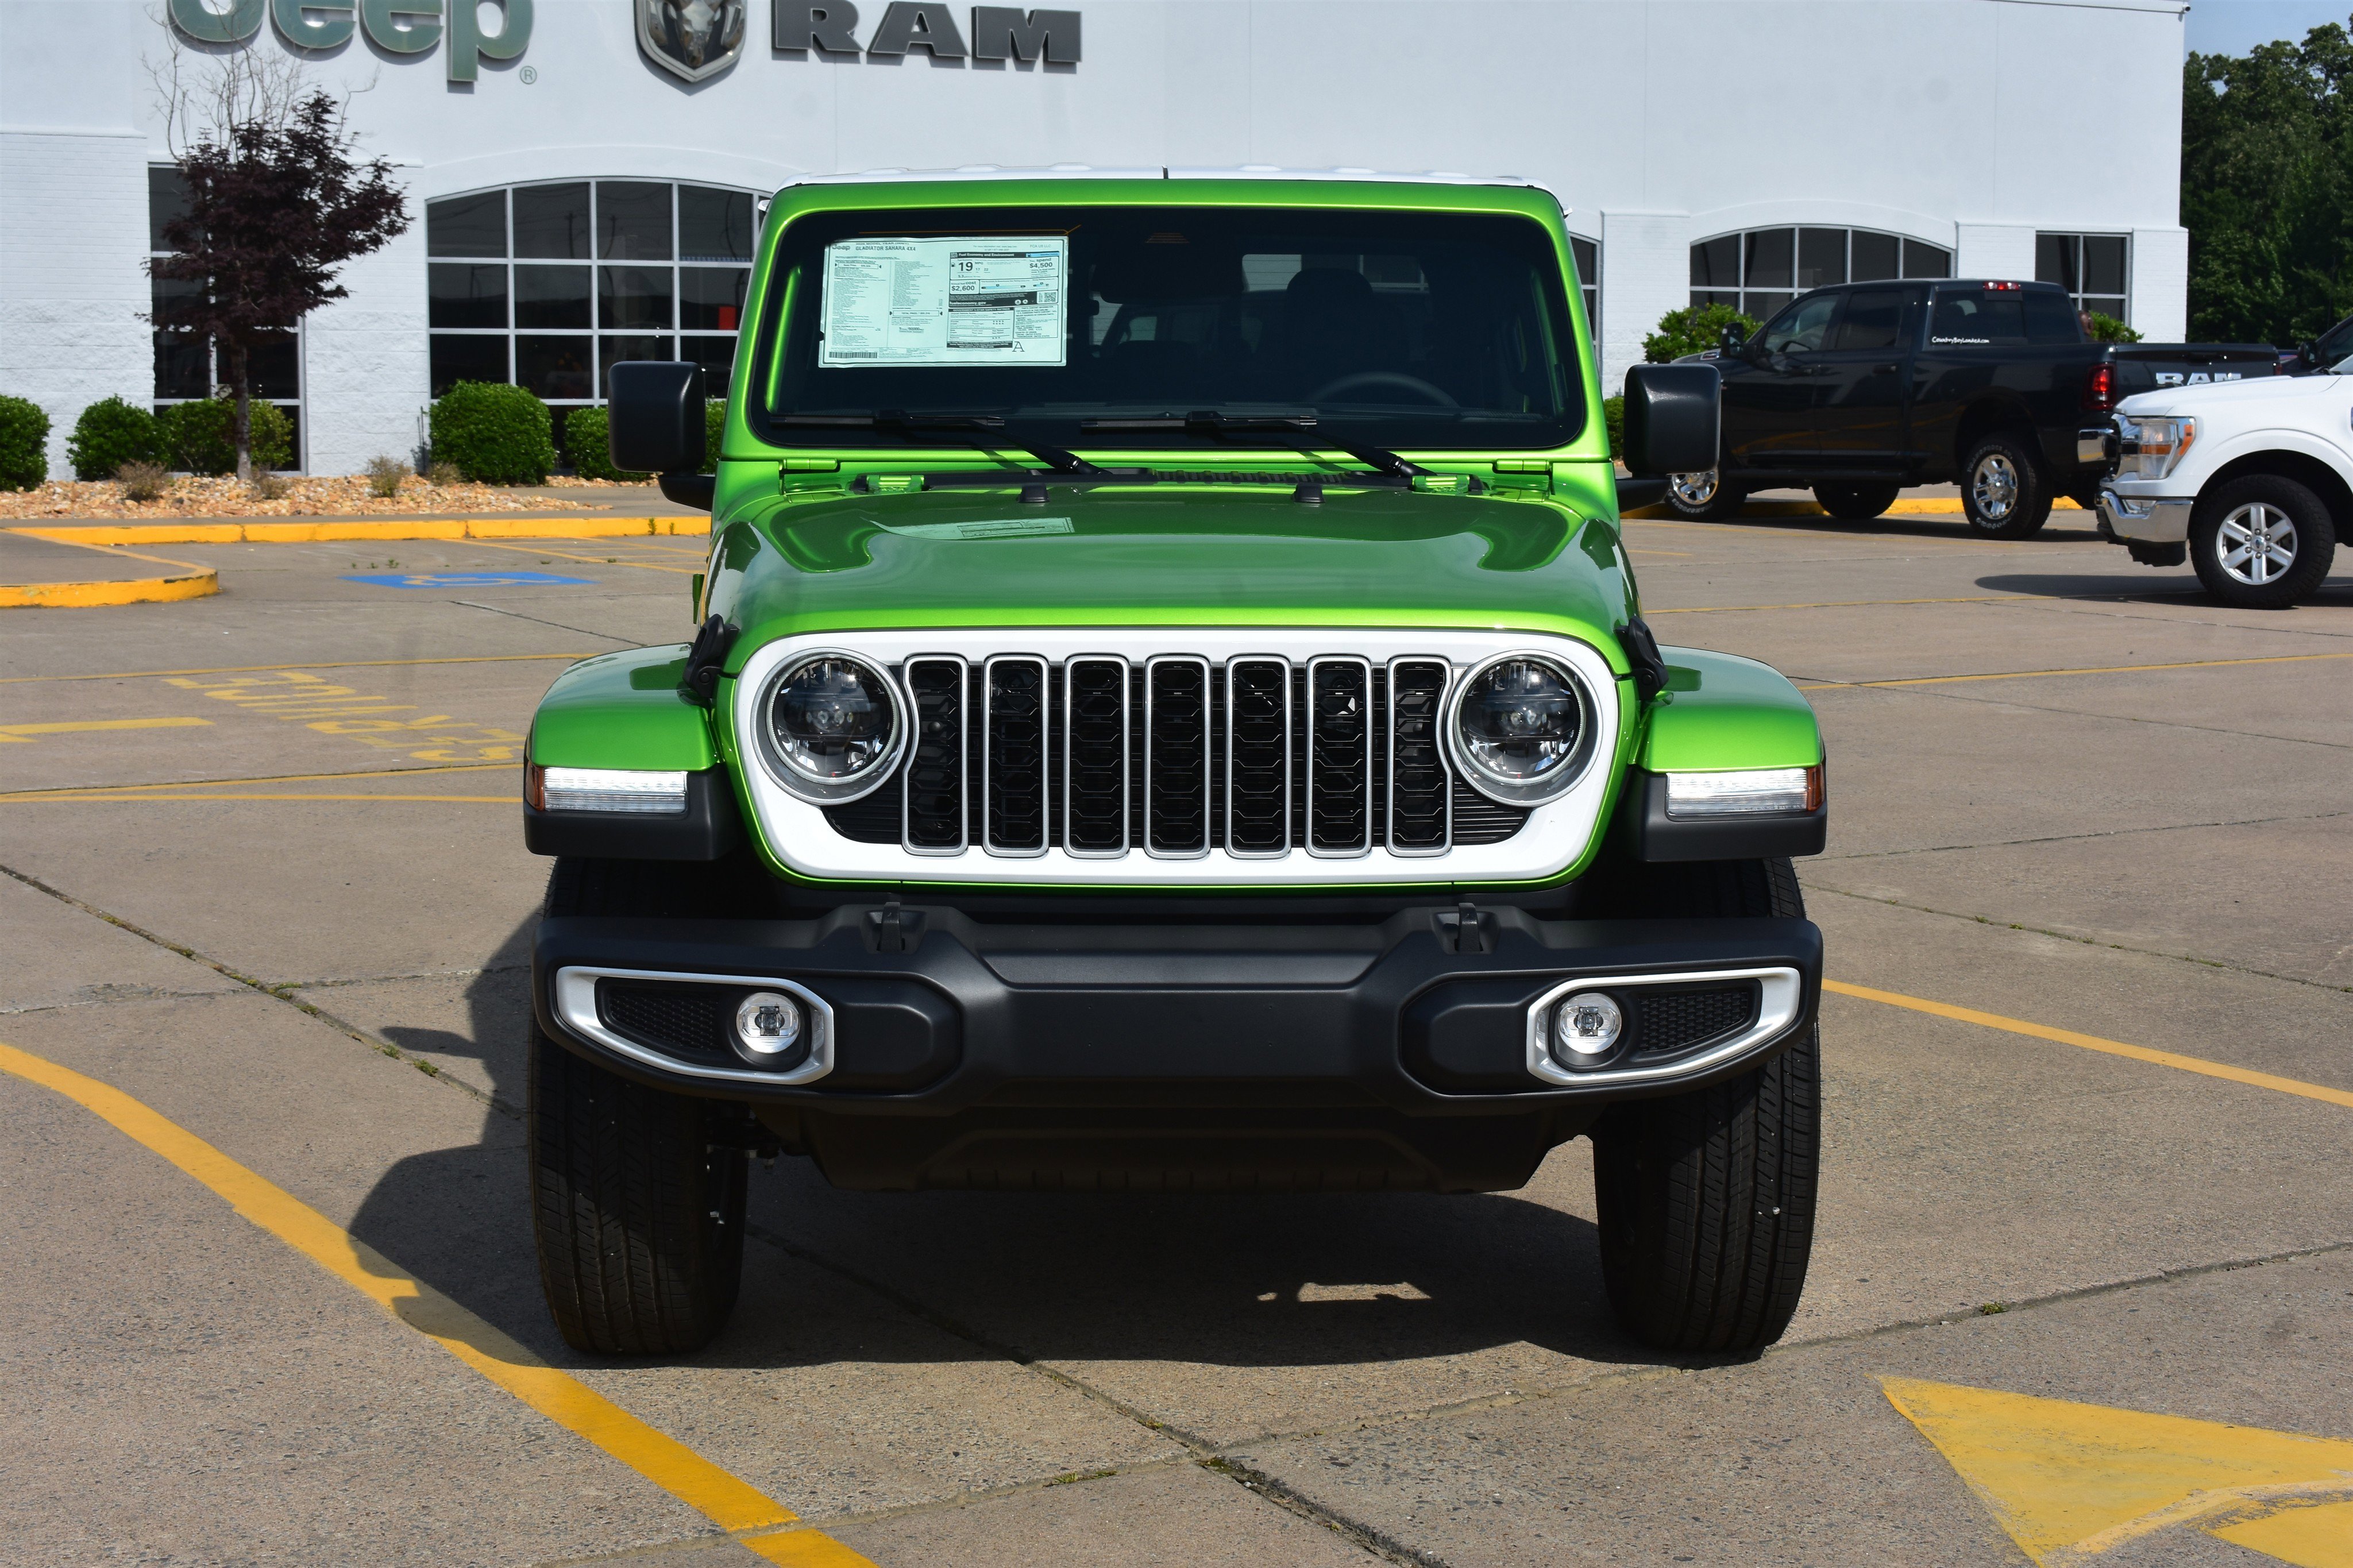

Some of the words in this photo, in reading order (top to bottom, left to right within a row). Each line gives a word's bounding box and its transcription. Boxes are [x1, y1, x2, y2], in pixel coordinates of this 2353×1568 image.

[771, 0, 1082, 63] RAM
[958, 261, 974, 272] 19
[1012, 341, 1025, 352] A
[2156, 372, 2242, 387] RAM
